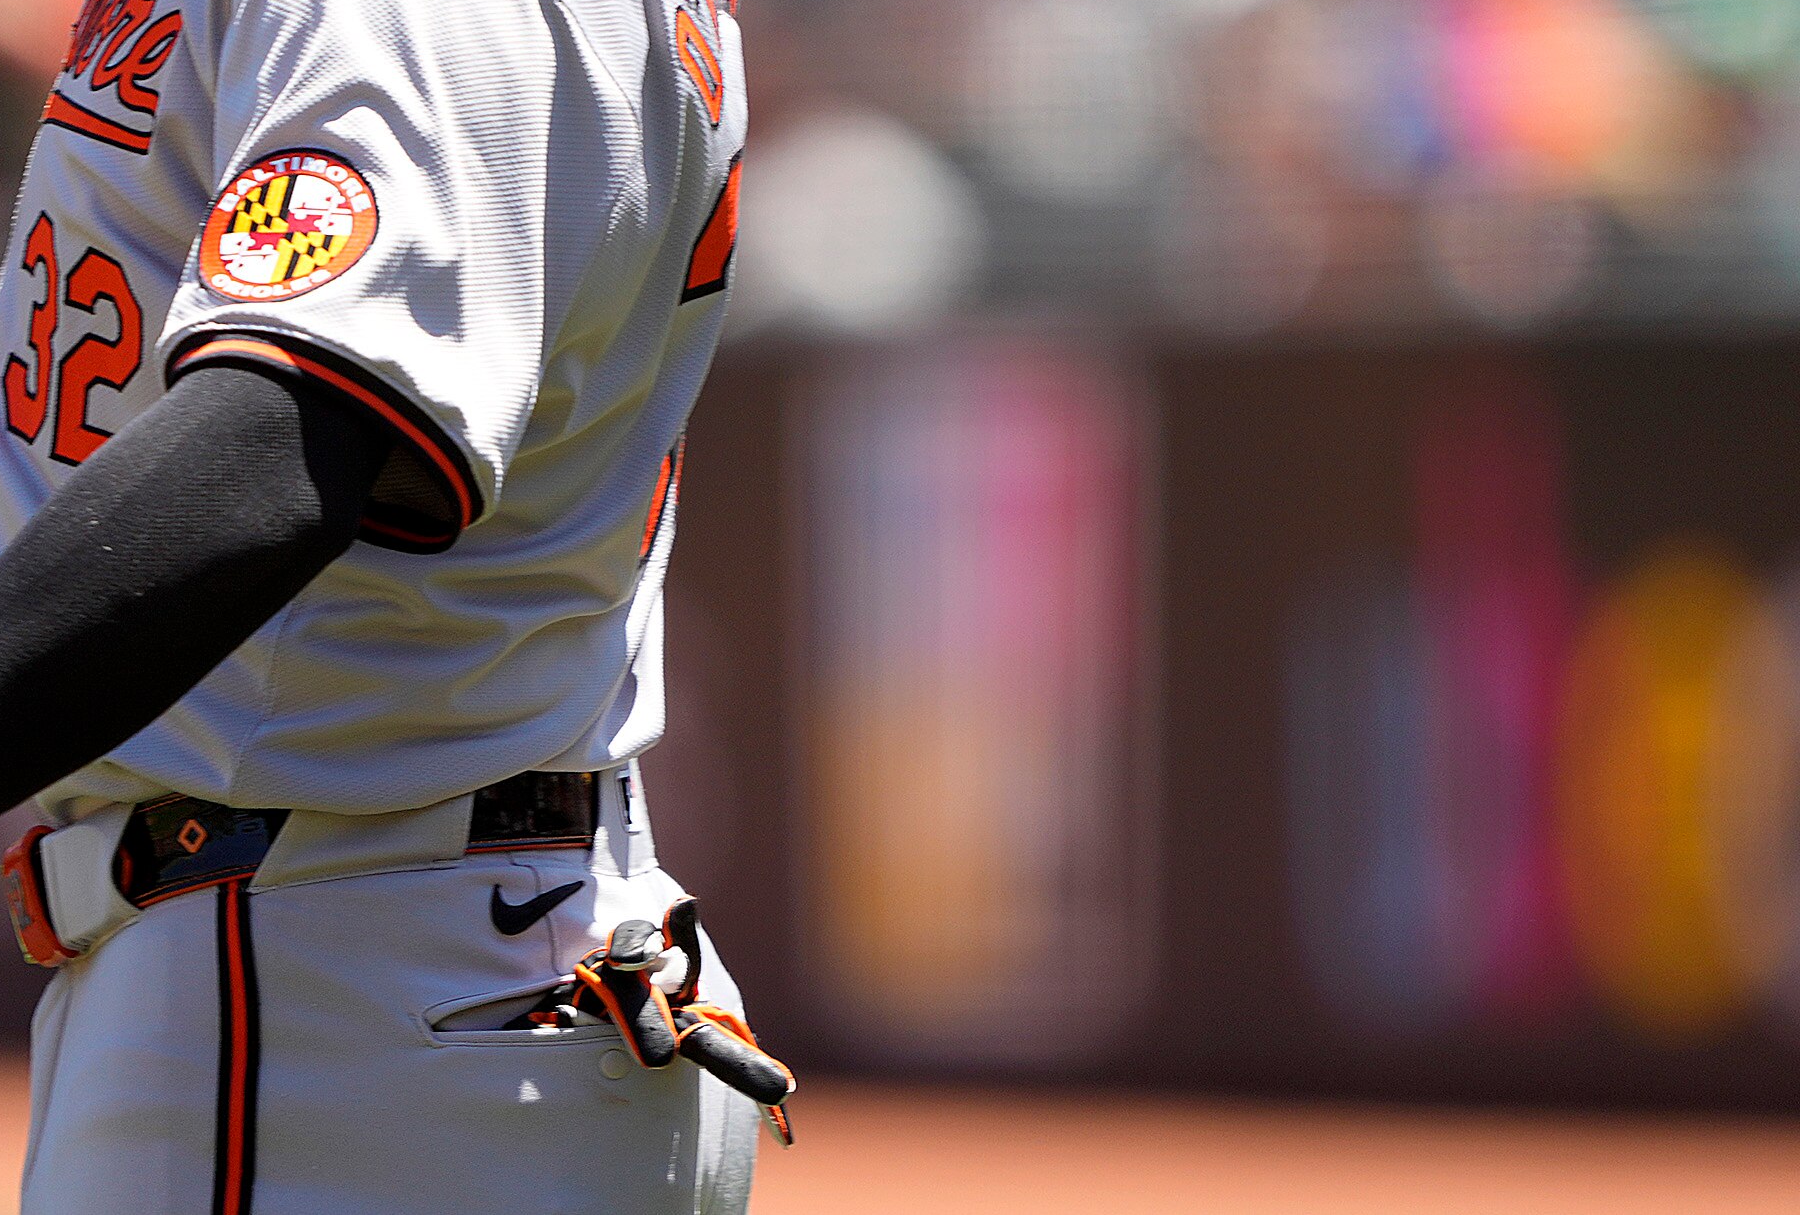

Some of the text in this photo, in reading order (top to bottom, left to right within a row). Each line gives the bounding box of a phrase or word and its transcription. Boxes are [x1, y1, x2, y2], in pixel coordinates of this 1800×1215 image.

[216, 156, 372, 213] BALTIMORE
[210, 269, 332, 299] ORIOLES
[3, 209, 145, 467] 32
